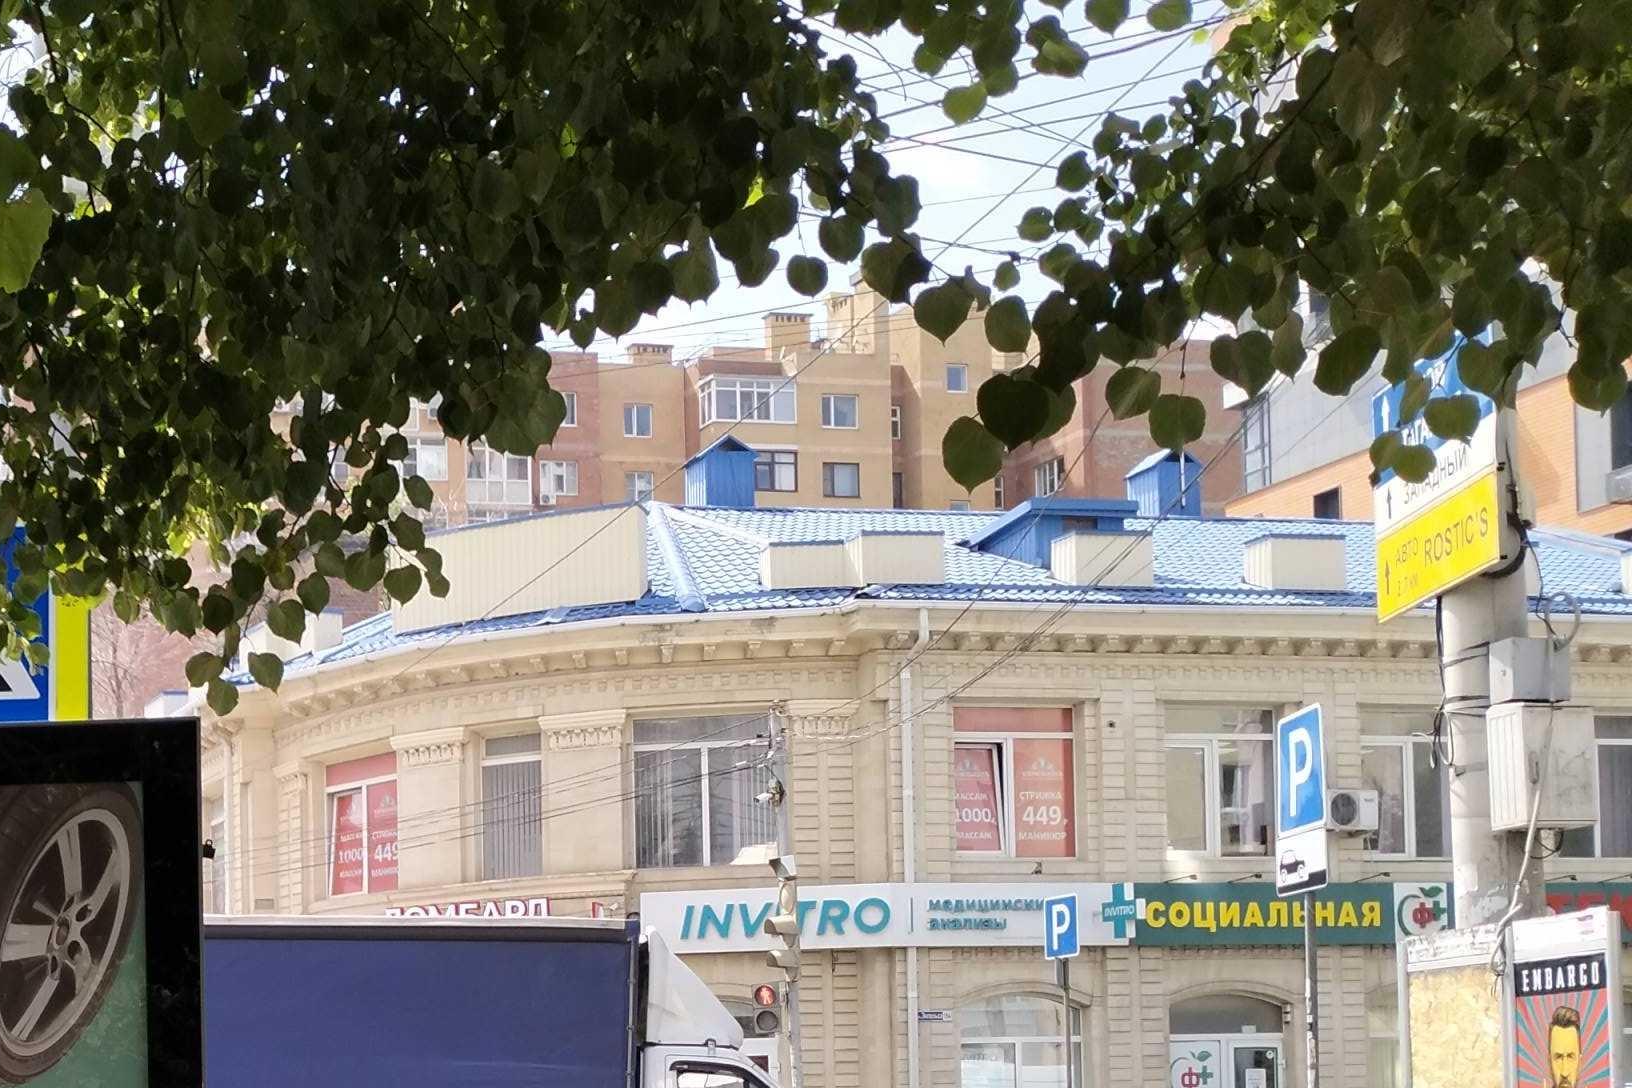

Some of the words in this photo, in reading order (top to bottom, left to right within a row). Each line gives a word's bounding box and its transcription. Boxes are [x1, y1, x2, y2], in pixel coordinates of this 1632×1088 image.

[1423, 506, 1489, 568] ROSTIC'S
[383, 896, 552, 918] МБАРД
[679, 896, 891, 940] INVTRO
[927, 898, 1044, 914] медицински
[1145, 901, 1382, 932] СОЦИАЛЬНАЯ
[927, 917, 1008, 932] анализы
[1521, 961, 1601, 992] EMBARGO
